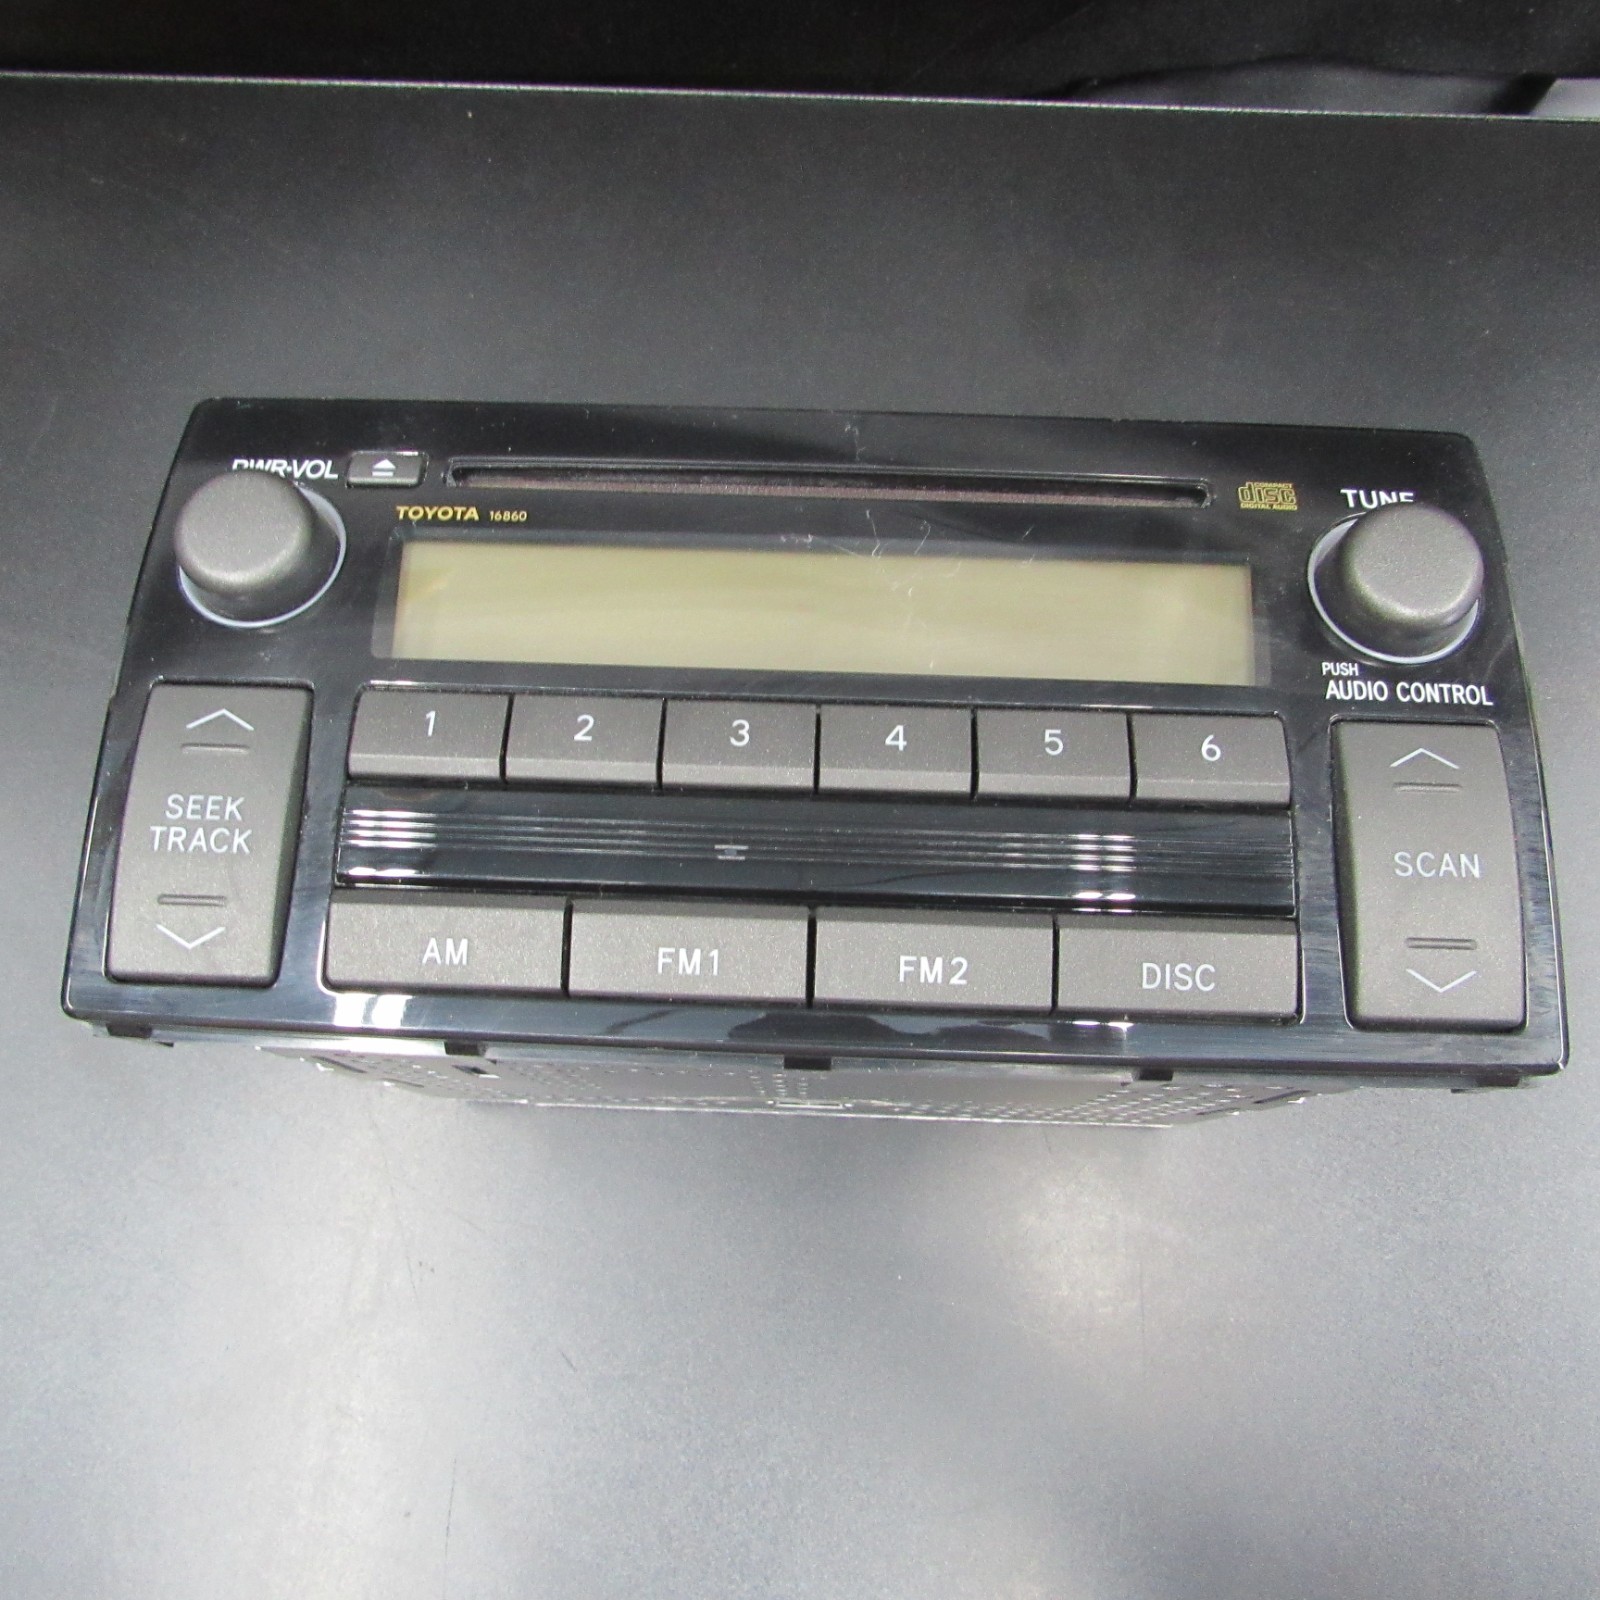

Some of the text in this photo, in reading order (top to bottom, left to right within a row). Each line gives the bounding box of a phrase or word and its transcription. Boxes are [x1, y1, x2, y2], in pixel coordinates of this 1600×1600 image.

[396, 505, 528, 522] TOYOTA 16860
[1321, 662, 1359, 676] PUSH
[1325, 680, 1494, 706] AUDIO CONTROL
[424, 711, 436, 737] 1
[573, 714, 595, 742] 2
[729, 719, 750, 747] 3
[885, 725, 907, 751] 4
[1044, 729, 1064, 755] 5
[1201, 734, 1222, 762] 6
[165, 793, 245, 821] SEEK
[150, 825, 252, 854] TRACK
[1393, 851, 1480, 879] SCAN
[422, 937, 469, 966] AM
[1141, 962, 1216, 992] DISC
